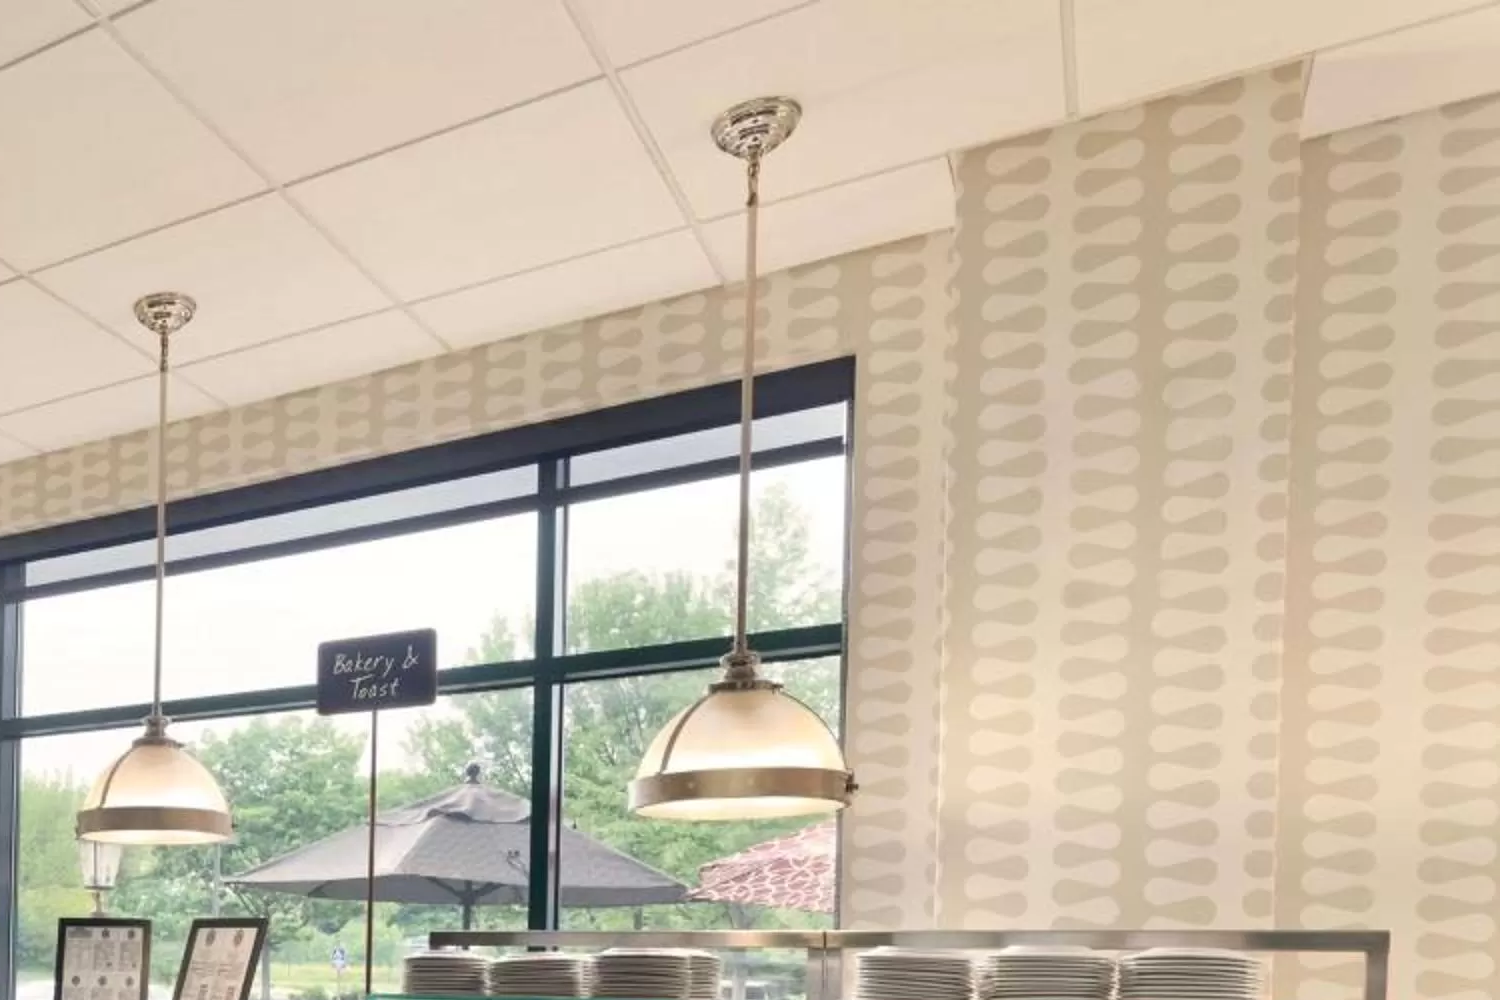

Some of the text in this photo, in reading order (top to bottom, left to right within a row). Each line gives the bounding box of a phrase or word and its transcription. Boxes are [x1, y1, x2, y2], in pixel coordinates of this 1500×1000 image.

[332, 644, 420, 679] Bakery &
[349, 673, 401, 700] Toast
